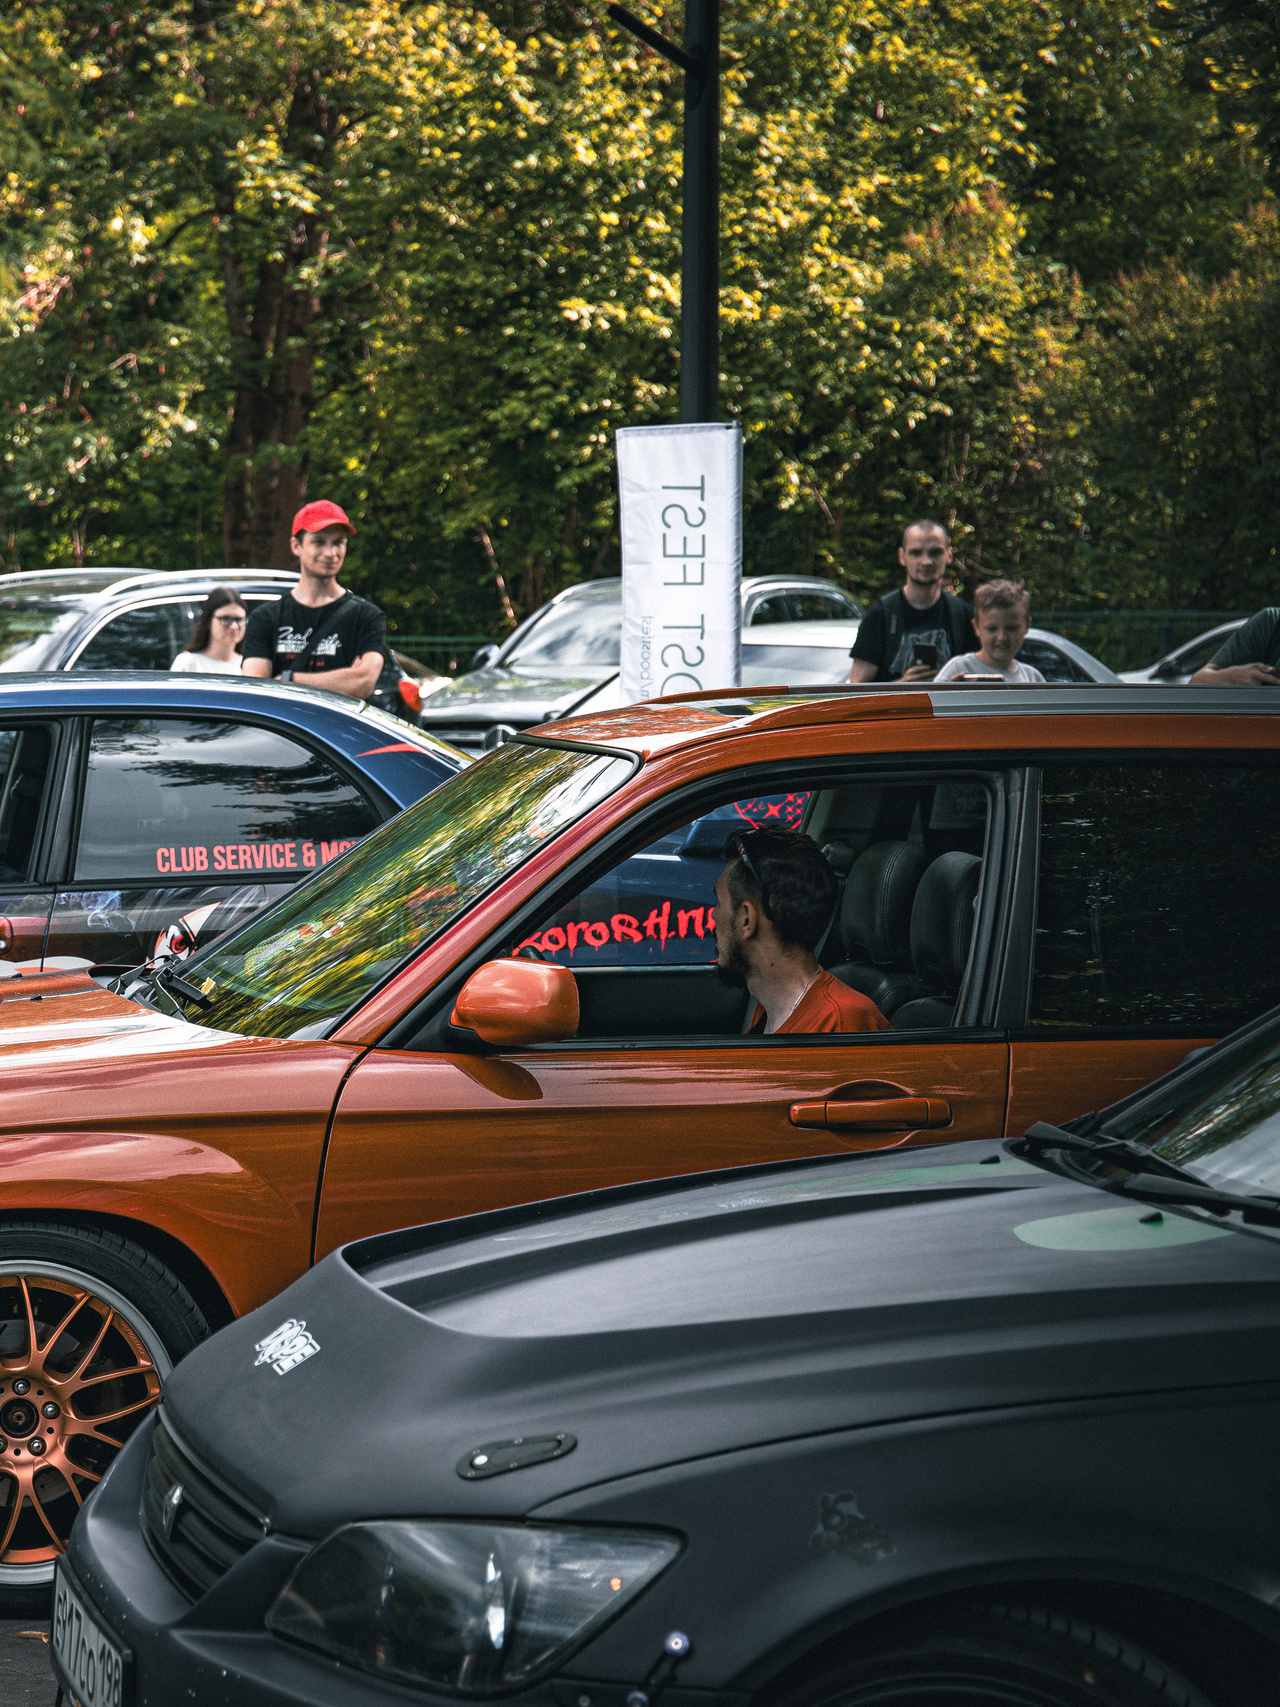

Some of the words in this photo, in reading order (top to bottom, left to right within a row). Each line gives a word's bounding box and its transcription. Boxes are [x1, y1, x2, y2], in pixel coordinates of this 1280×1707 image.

[156, 846, 209, 873] CLUB
[213, 843, 298, 870] SERVICE
[302, 842, 317, 867] &
[99, 1642, 122, 1707] 198
